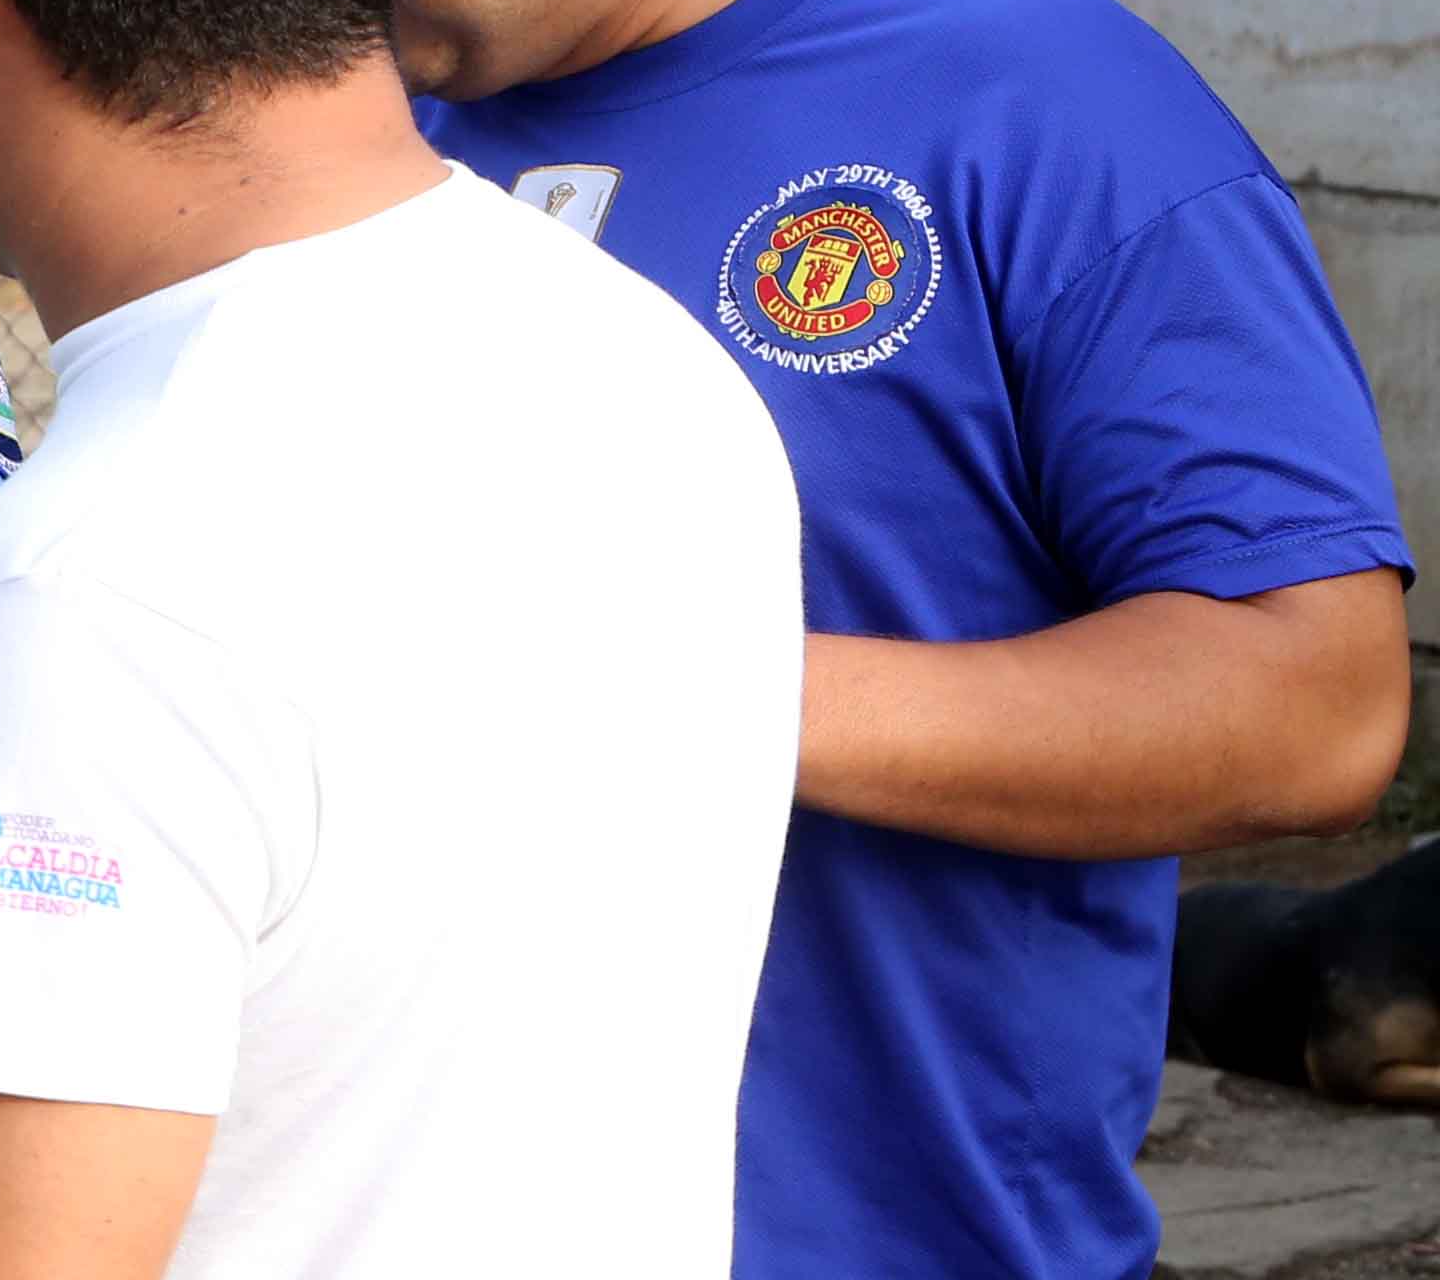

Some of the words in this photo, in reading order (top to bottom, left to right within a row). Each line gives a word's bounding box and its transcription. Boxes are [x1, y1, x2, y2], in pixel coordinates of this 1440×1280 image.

[776, 166, 829, 205] MAY
[835, 164, 893, 188] 29TH
[892, 179, 933, 220] 1968
[782, 211, 891, 266] MANCHESTER
[766, 295, 846, 332] UNITED
[753, 325, 910, 375] ANNIVERSARY
